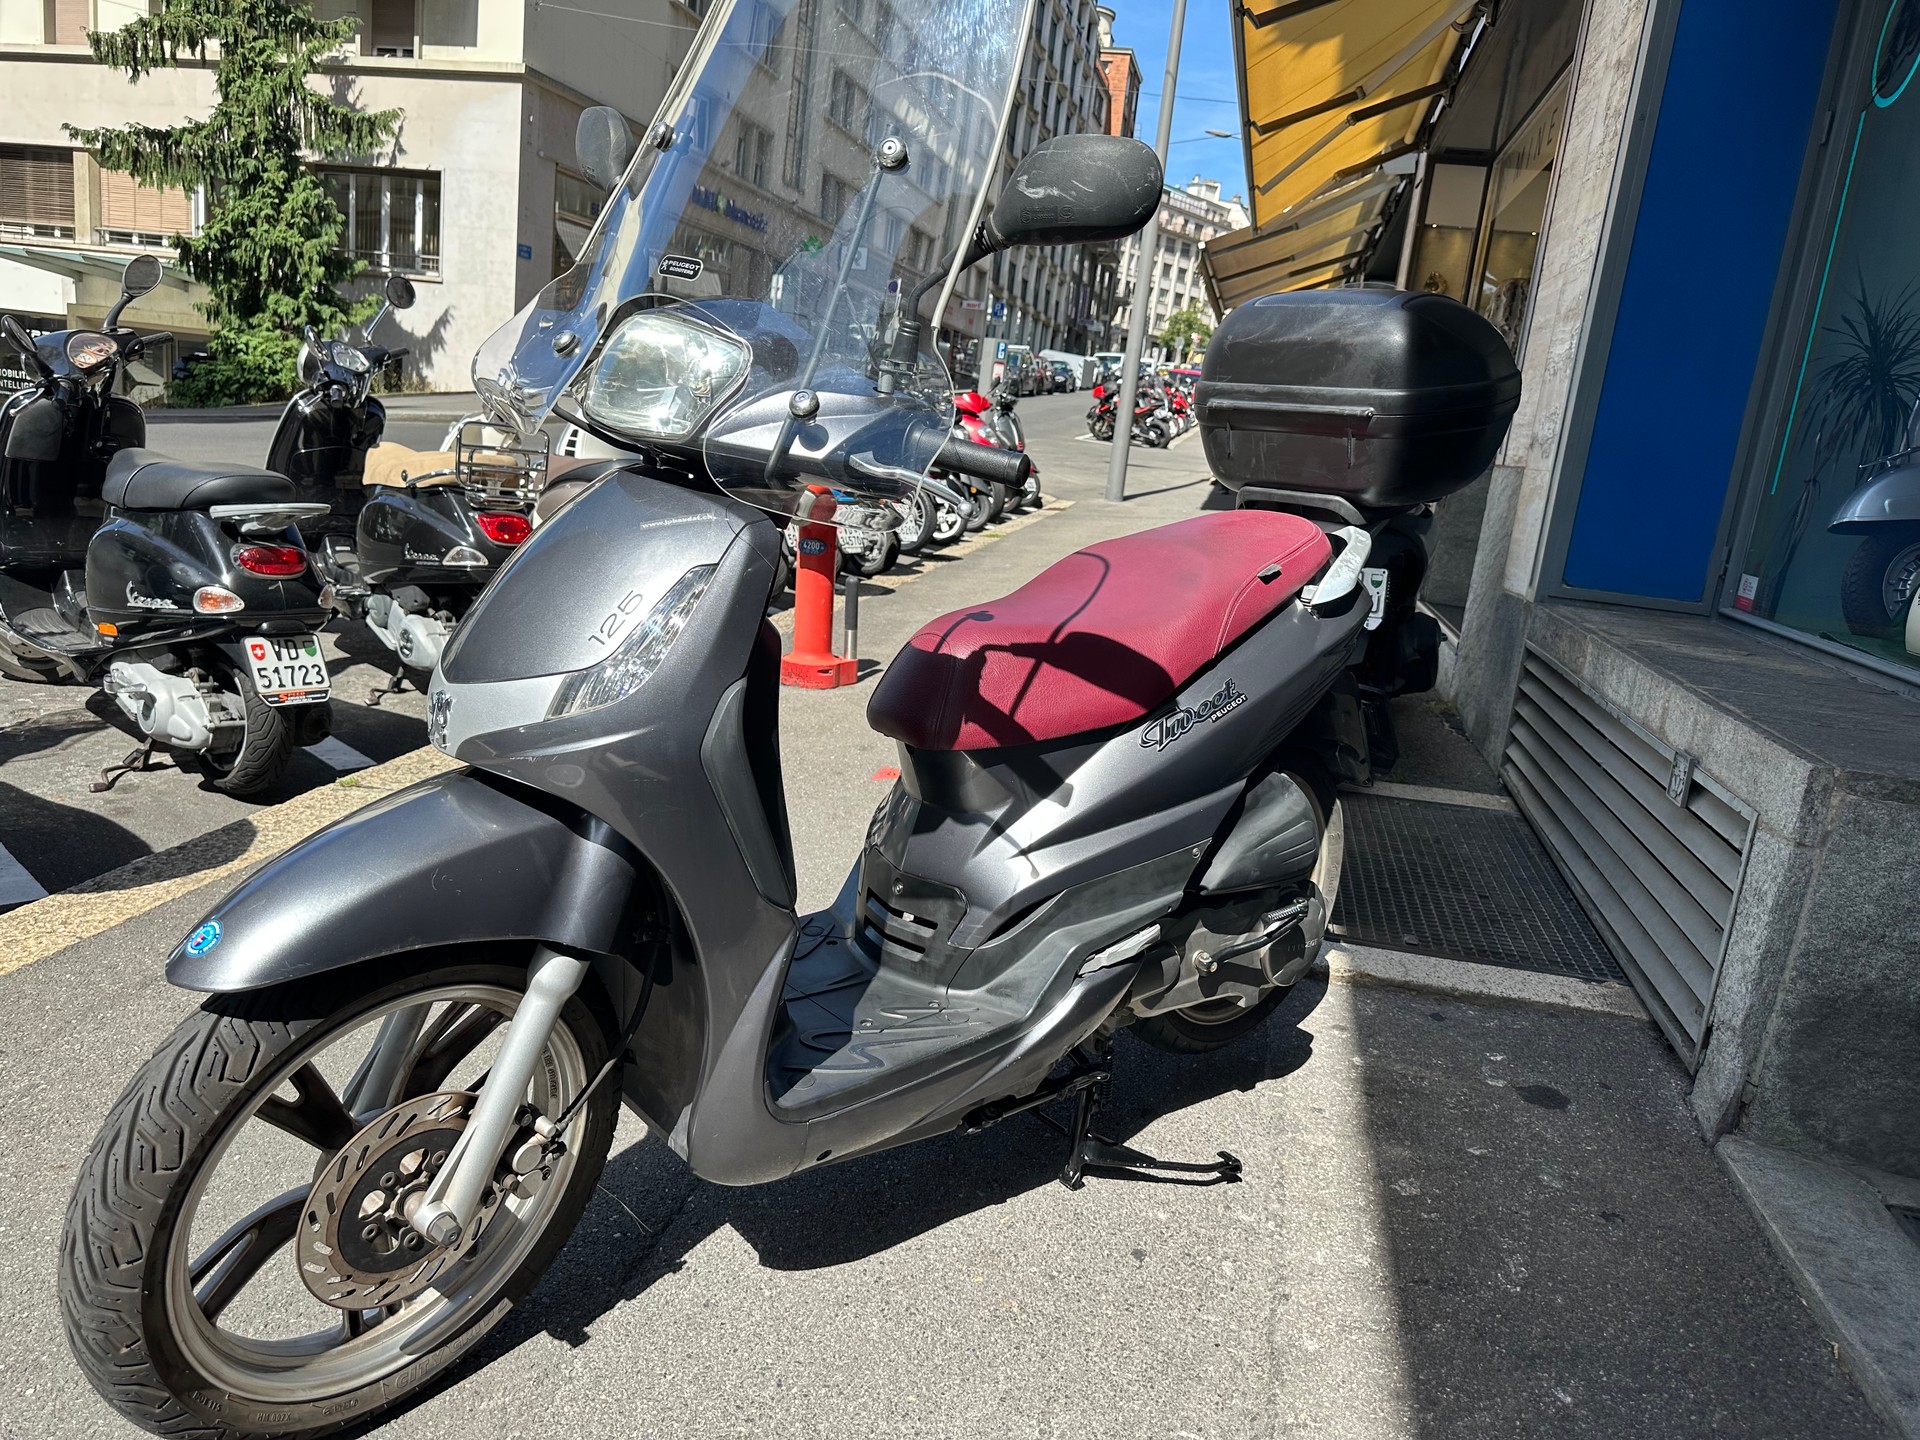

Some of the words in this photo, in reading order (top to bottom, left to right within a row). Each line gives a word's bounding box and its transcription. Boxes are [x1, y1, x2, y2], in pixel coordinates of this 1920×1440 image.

[669, 260, 700, 271] PEUGEOT
[669, 267, 694, 275] SCOOTERS
[803, 543, 820, 551] 4200
[126, 580, 179, 609] Vespa
[588, 590, 643, 645] 125
[270, 639, 299, 661] VD
[257, 664, 325, 689] 51723
[1139, 678, 1240, 752] Tweet
[1210, 694, 1247, 721] PEUGEOT
[395, 1347, 447, 1389] CITY
